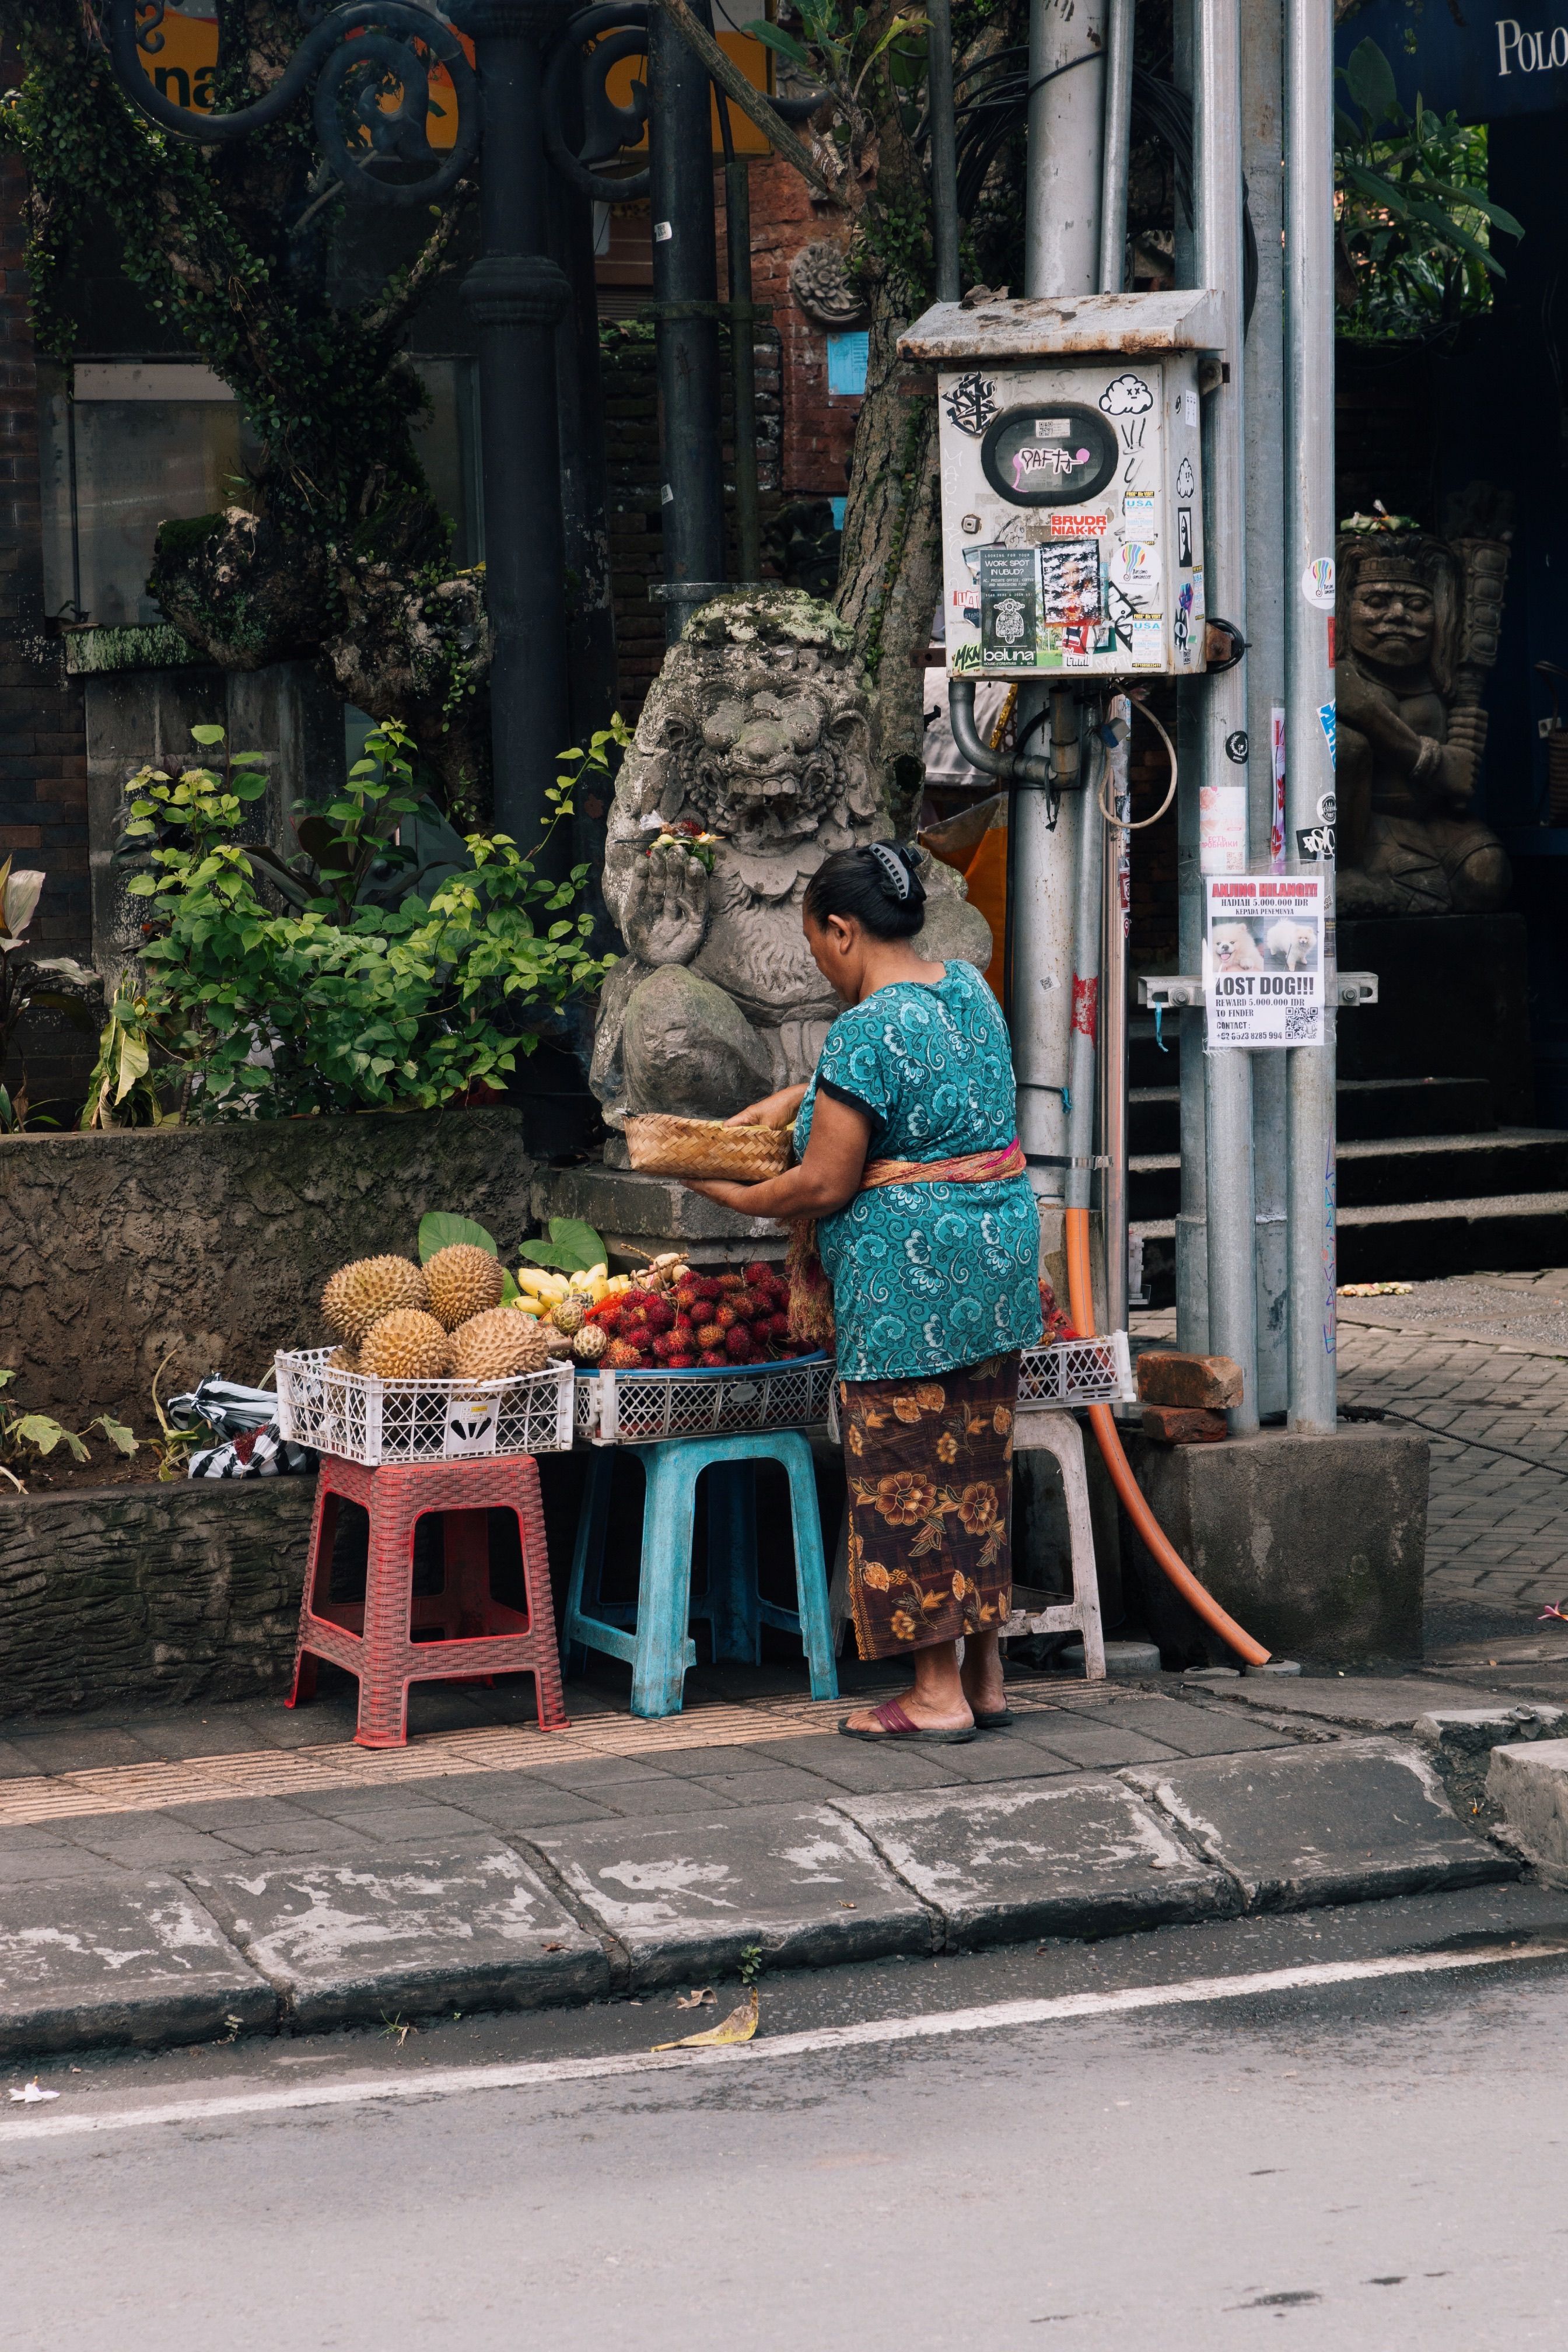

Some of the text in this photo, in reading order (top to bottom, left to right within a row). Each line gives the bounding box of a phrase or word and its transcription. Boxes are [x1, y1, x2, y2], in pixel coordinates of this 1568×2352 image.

[1495, 19, 1568, 76] POLO
[1052, 516, 1107, 525] BRUDR
[1200, 841, 1238, 849] ПРОБНИКИ
[1212, 883, 1318, 897] ANJING HILANG!!!
[1216, 977, 1314, 996] LOST DOG!!!
[1251, 1031, 1267, 1040] 8285
